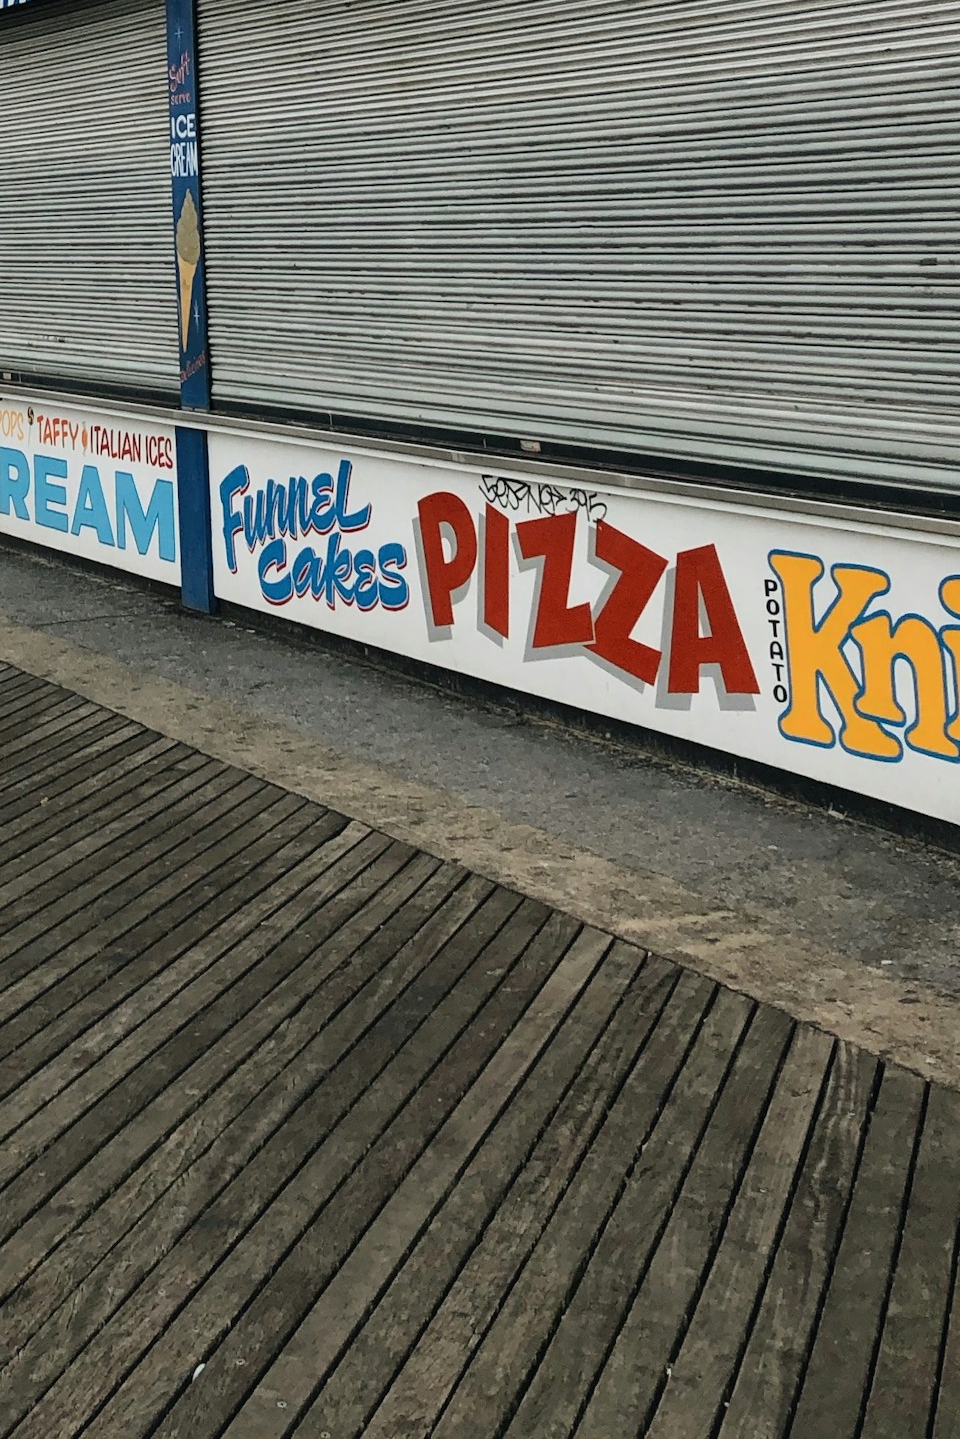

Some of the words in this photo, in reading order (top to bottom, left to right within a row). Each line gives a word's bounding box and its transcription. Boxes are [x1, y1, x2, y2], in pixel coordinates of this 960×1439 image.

[171, 113, 197, 140] ICE
[170, 141, 199, 178] CREAM
[36, 415, 79, 451] TAFFY
[90, 425, 142, 464] ITALIAN
[145, 434, 174, 470] ICES
[411, 491, 761, 712] PIZZA
[764, 579, 788, 703] POTATO
